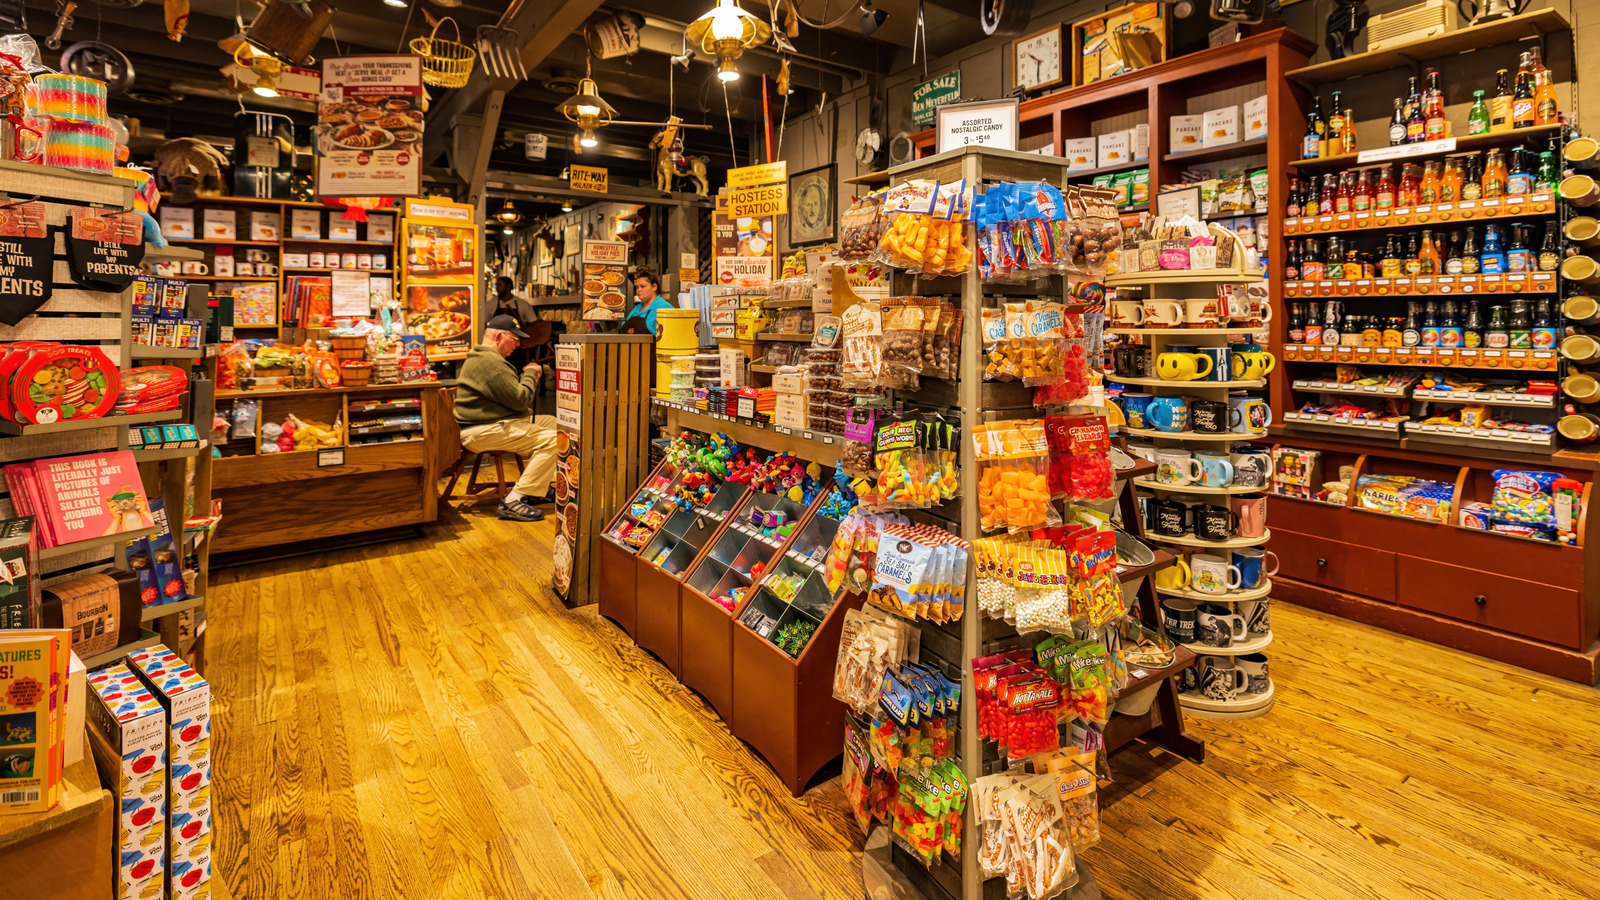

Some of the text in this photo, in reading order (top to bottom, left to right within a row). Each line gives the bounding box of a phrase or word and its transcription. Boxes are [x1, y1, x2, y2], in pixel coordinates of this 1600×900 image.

[913, 76, 957, 101] FOR SALE
[913, 101, 925, 112] BEN
[962, 118, 993, 126] ASSORTED
[1209, 119, 1233, 128] PANCAKE
[952, 124, 1004, 134] NOSTALGIC CANDY
[964, 136, 969, 145] 3
[1103, 142, 1125, 150] PANCAKE
[572, 169, 607, 183] RITE-WAY
[731, 188, 783, 204] HOSTESS
[736, 202, 779, 216] STATION
[103, 241, 122, 250] STILL
[94, 247, 128, 258] LIVE WITH
[7, 254, 33, 267] WITH
[106, 256, 117, 264] MY
[87, 262, 136, 276] PARENTS
[735, 265, 767, 274] HOLIDAY
[0, 277, 43, 297] ENTS
[844, 315, 858, 325] COW
[1035, 310, 1060, 323] Vanilla
[844, 321, 860, 332] TALES
[1031, 318, 1063, 337] CARAMELS
[47, 347, 92, 358] DOG TREATS
[745, 387, 754, 395] SALE
[882, 428, 896, 439] SOUR
[1069, 424, 1105, 437] CINNAMON
[879, 434, 915, 447] GUMMY WORMS
[1076, 432, 1103, 443] BEARS
[48, 458, 108, 473] THIS BOOK IS
[51, 465, 122, 483] LITERALLY JUST
[54, 476, 111, 492] PICTURES OF
[58, 487, 100, 502] ANIMALS
[60, 497, 101, 511] SILENTLY
[63, 506, 103, 521] JUDGING
[65, 519, 85, 531] YOU
[884, 556, 911, 572] SEA SALT
[1020, 562, 1033, 570] MINI
[877, 562, 913, 585] CARAMELS
[1165, 616, 1195, 630] TAR TREK
[1072, 657, 1092, 671] Mike
[1012, 692, 1028, 706] HOT
[176, 701, 206, 714] COFFEE HOUSE
[189, 704, 207, 714] SAMPLER
[891, 703, 905, 720] BEARS
[127, 732, 162, 748] SYRUP SAMPLER
[128, 729, 161, 743] COFFEE HOUSE
[1021, 806, 1032, 825] COW
[1024, 811, 1037, 835] TALES
